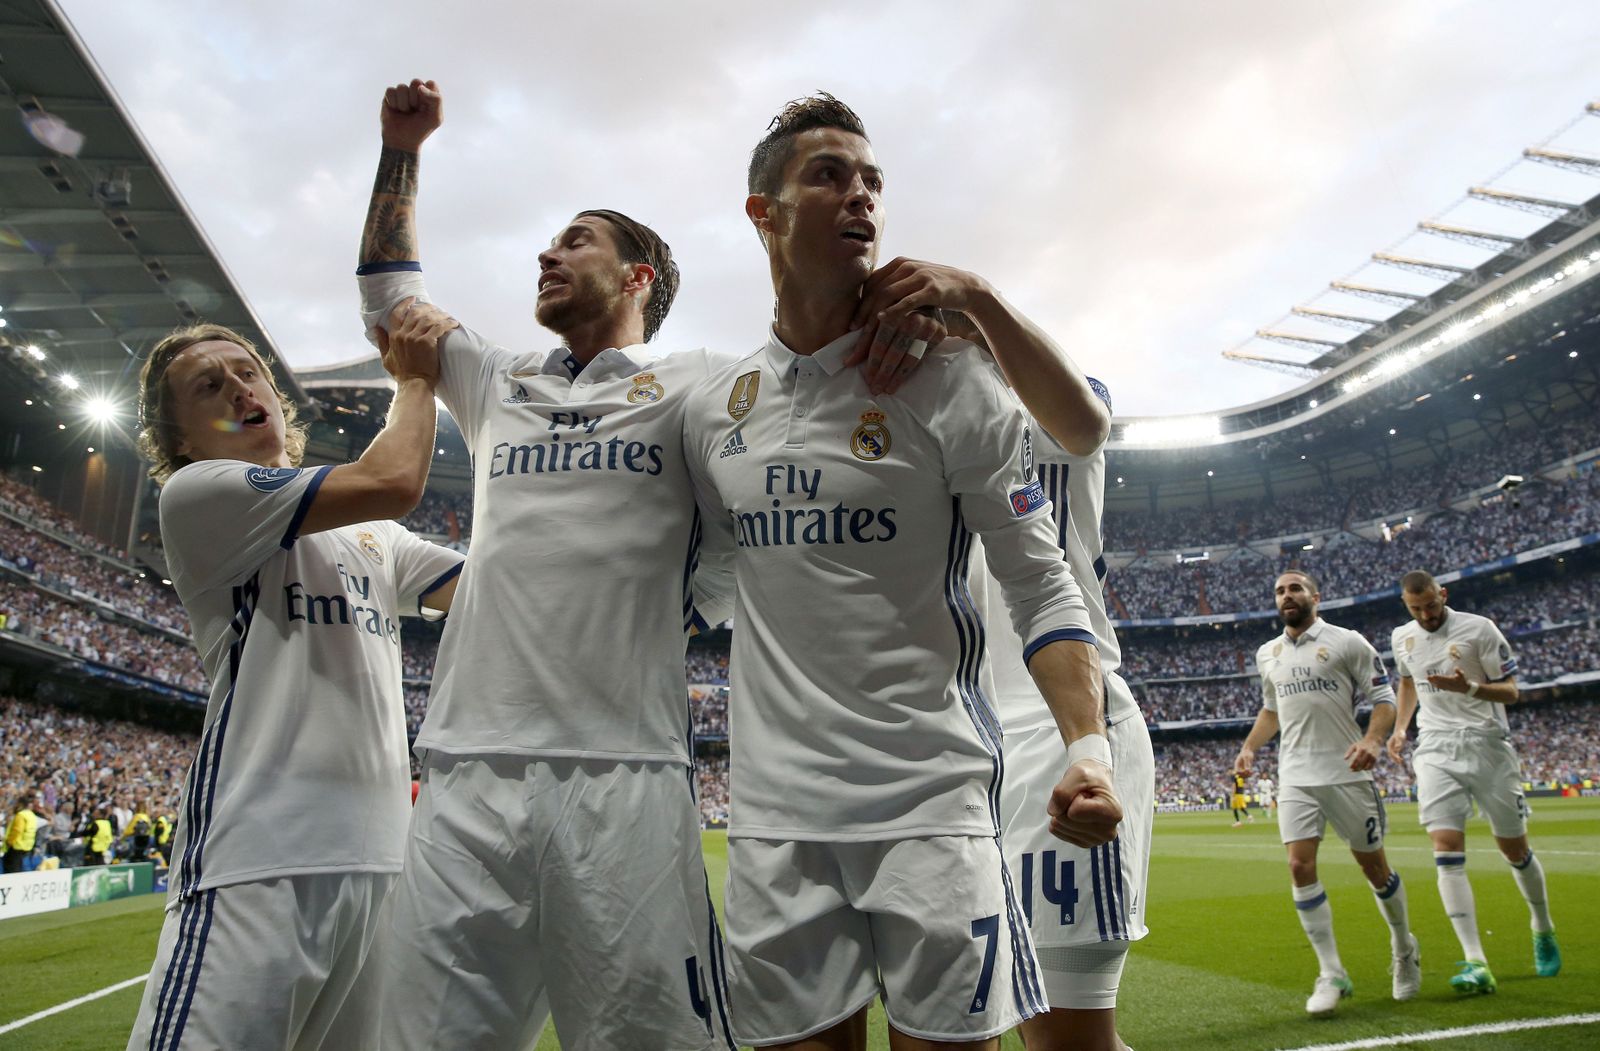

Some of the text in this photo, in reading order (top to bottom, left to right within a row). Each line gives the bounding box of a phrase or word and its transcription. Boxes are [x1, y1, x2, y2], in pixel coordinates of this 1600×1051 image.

[734, 401, 750, 410] FIFA
[548, 412, 603, 434] Fly
[489, 433, 663, 480] Emirates
[719, 445, 748, 459] adidas
[765, 465, 821, 500] Fly
[1026, 486, 1044, 505] RESP
[728, 499, 897, 547] mirates
[1291, 666, 1311, 678] Fly
[1276, 677, 1339, 697] Emirates
[1366, 816, 1379, 845] 2
[22, 881, 69, 902] XPERIA
[1021, 850, 1079, 929] 14
[969, 914, 1000, 1014] 7
